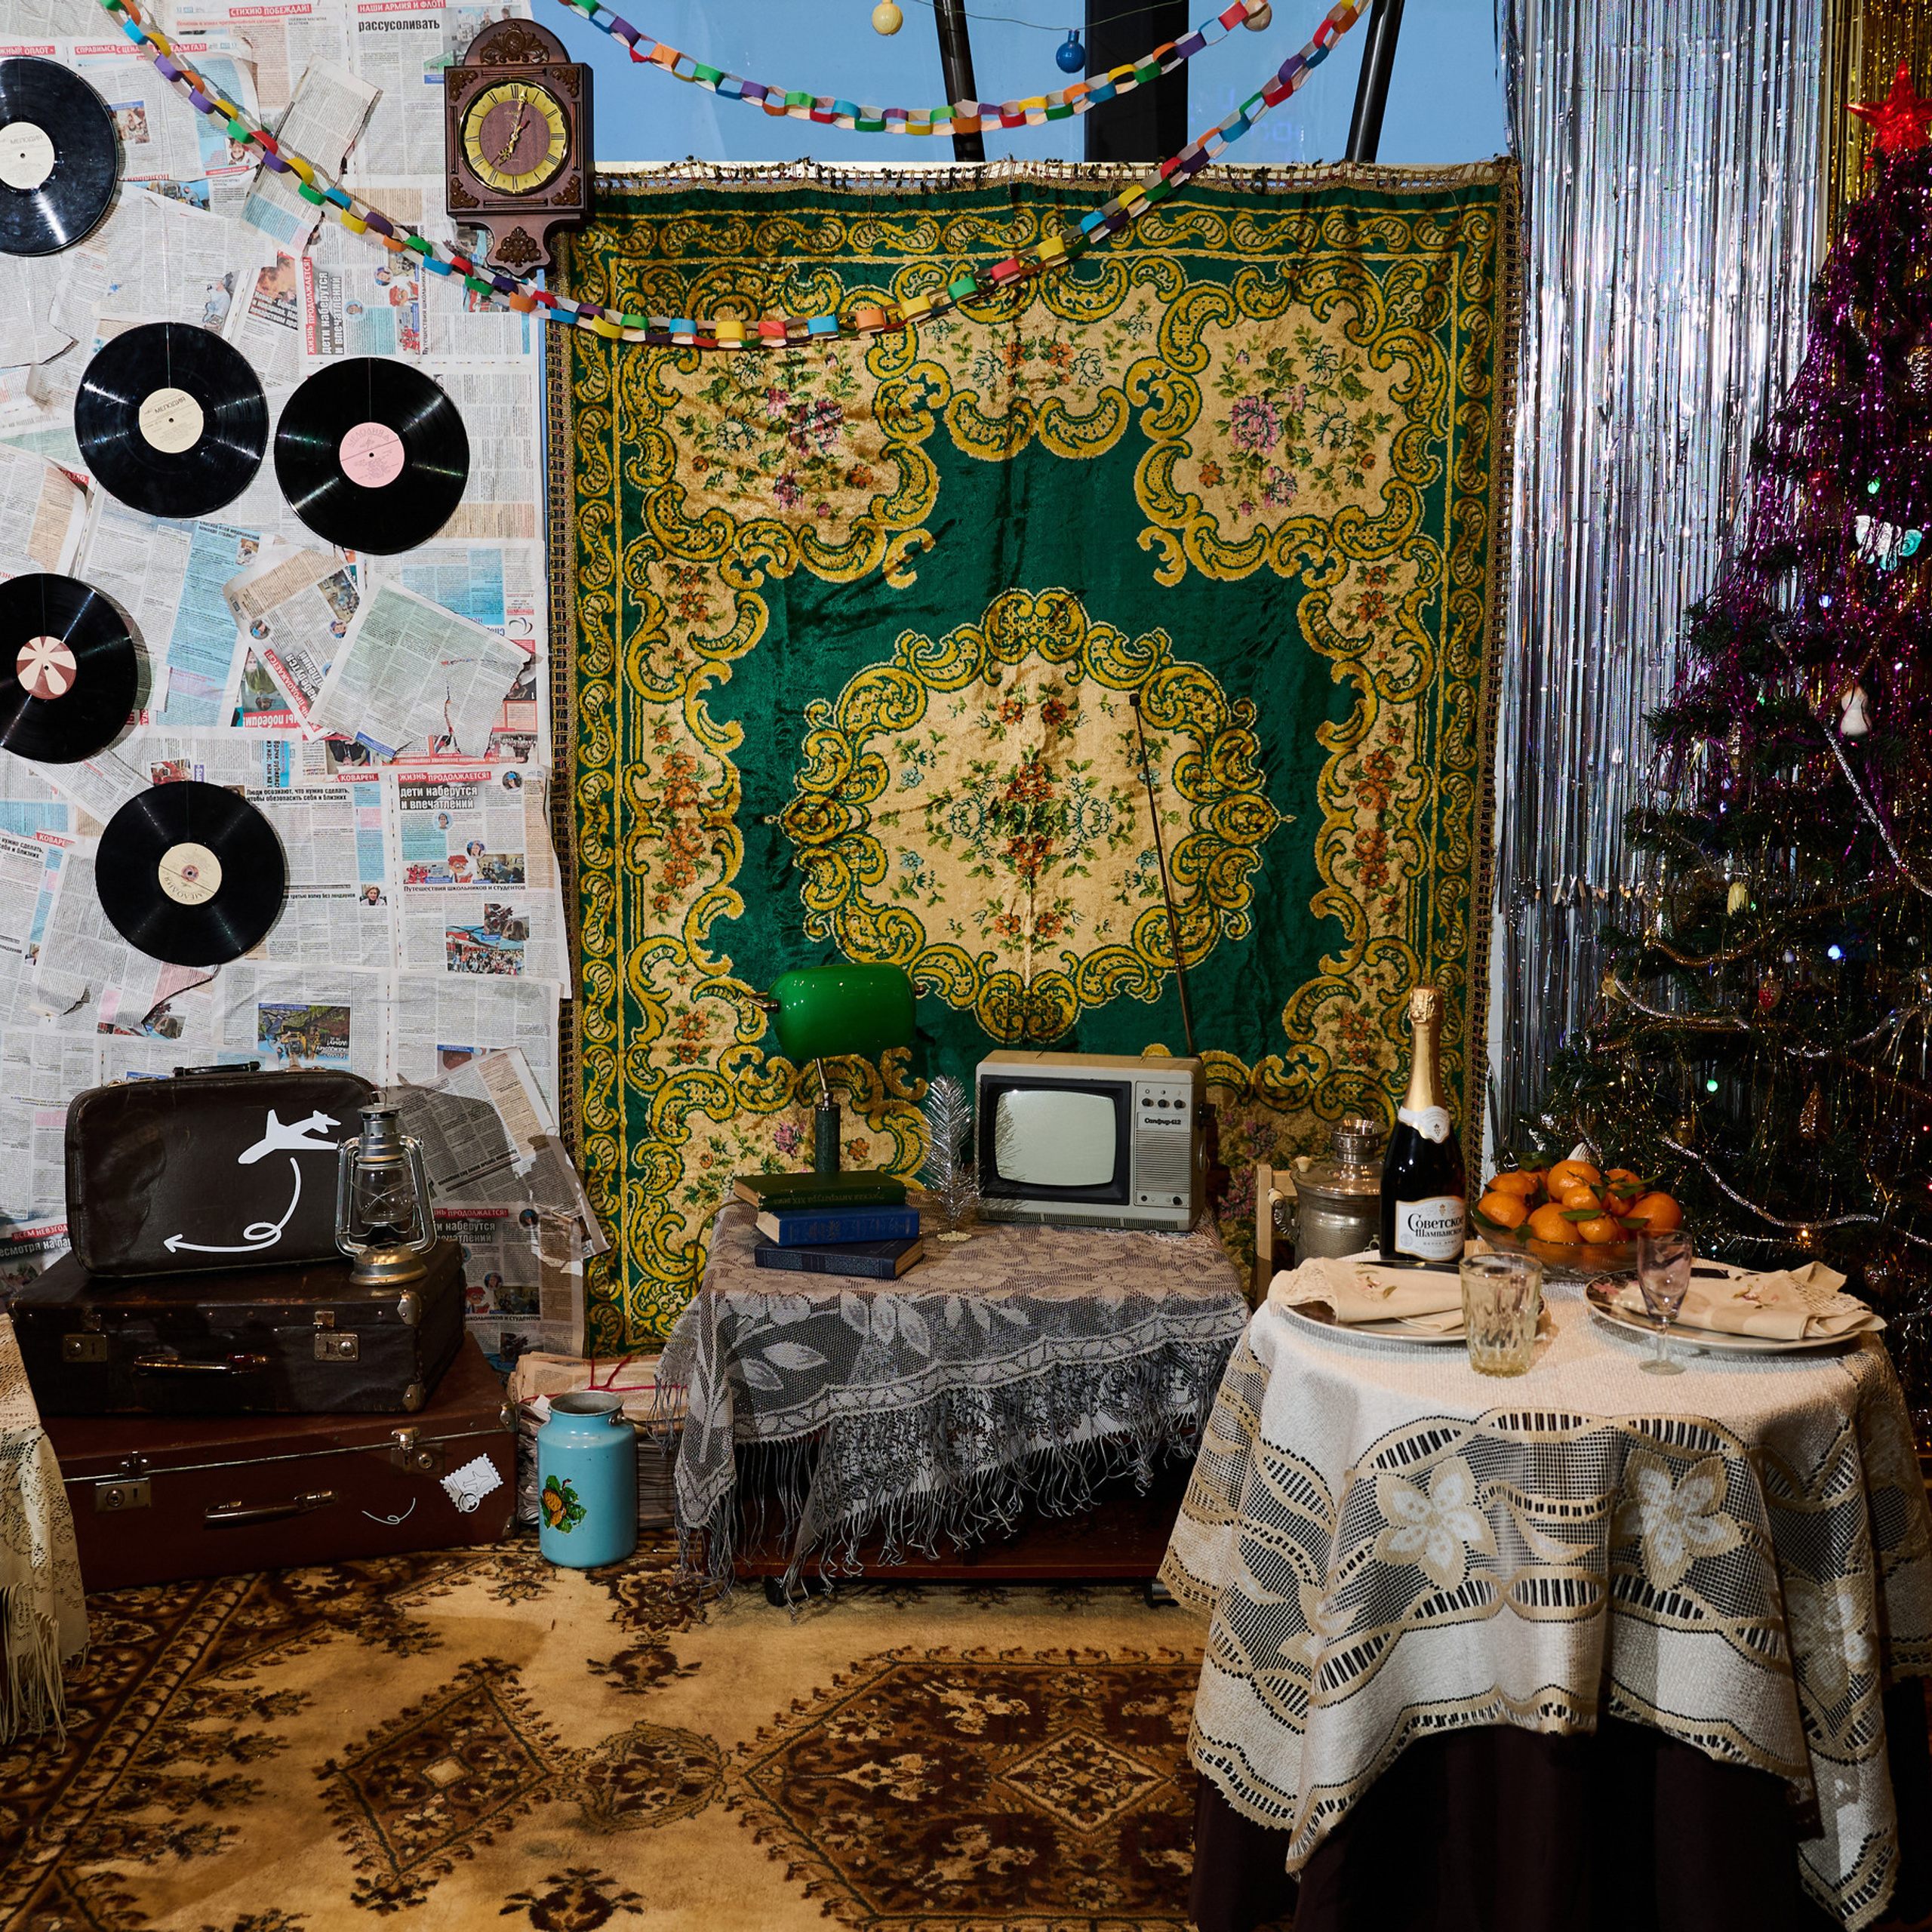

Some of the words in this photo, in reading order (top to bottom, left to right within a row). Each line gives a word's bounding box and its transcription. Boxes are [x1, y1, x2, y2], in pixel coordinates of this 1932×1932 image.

[230, 7, 262, 17] СТИХИЮ
[264, 4, 310, 15] ПОБЕЖДАЙ!
[359, 4, 383, 13] НАШИ
[384, 2, 411, 11] АРМИЯ
[358, 20, 440, 32] рассусоливать
[303, 257, 316, 325] ПРОДОЛЖАЕТСЯ!
[318, 272, 331, 327] наберутся
[331, 276, 343, 344] впечатлений
[307, 325, 315, 354] ЖИЗНЬ
[321, 329, 331, 354] дети
[155, 396, 186, 413] МЕЛОДИЯ
[340, 774, 377, 782] КОВАРЕН.
[428, 771, 490, 782] ПРОДОЛЖАЕТСЯ!
[401, 787, 423, 798] дети
[426, 785, 478, 796] наберутся
[401, 801, 408, 809] и
[410, 798, 474, 809] впечатлений
[39, 835, 66, 846] КОВАРЕ
[445, 1220, 496, 1232] наберутся
[14, 1230, 35, 1239] ВСЕМ
